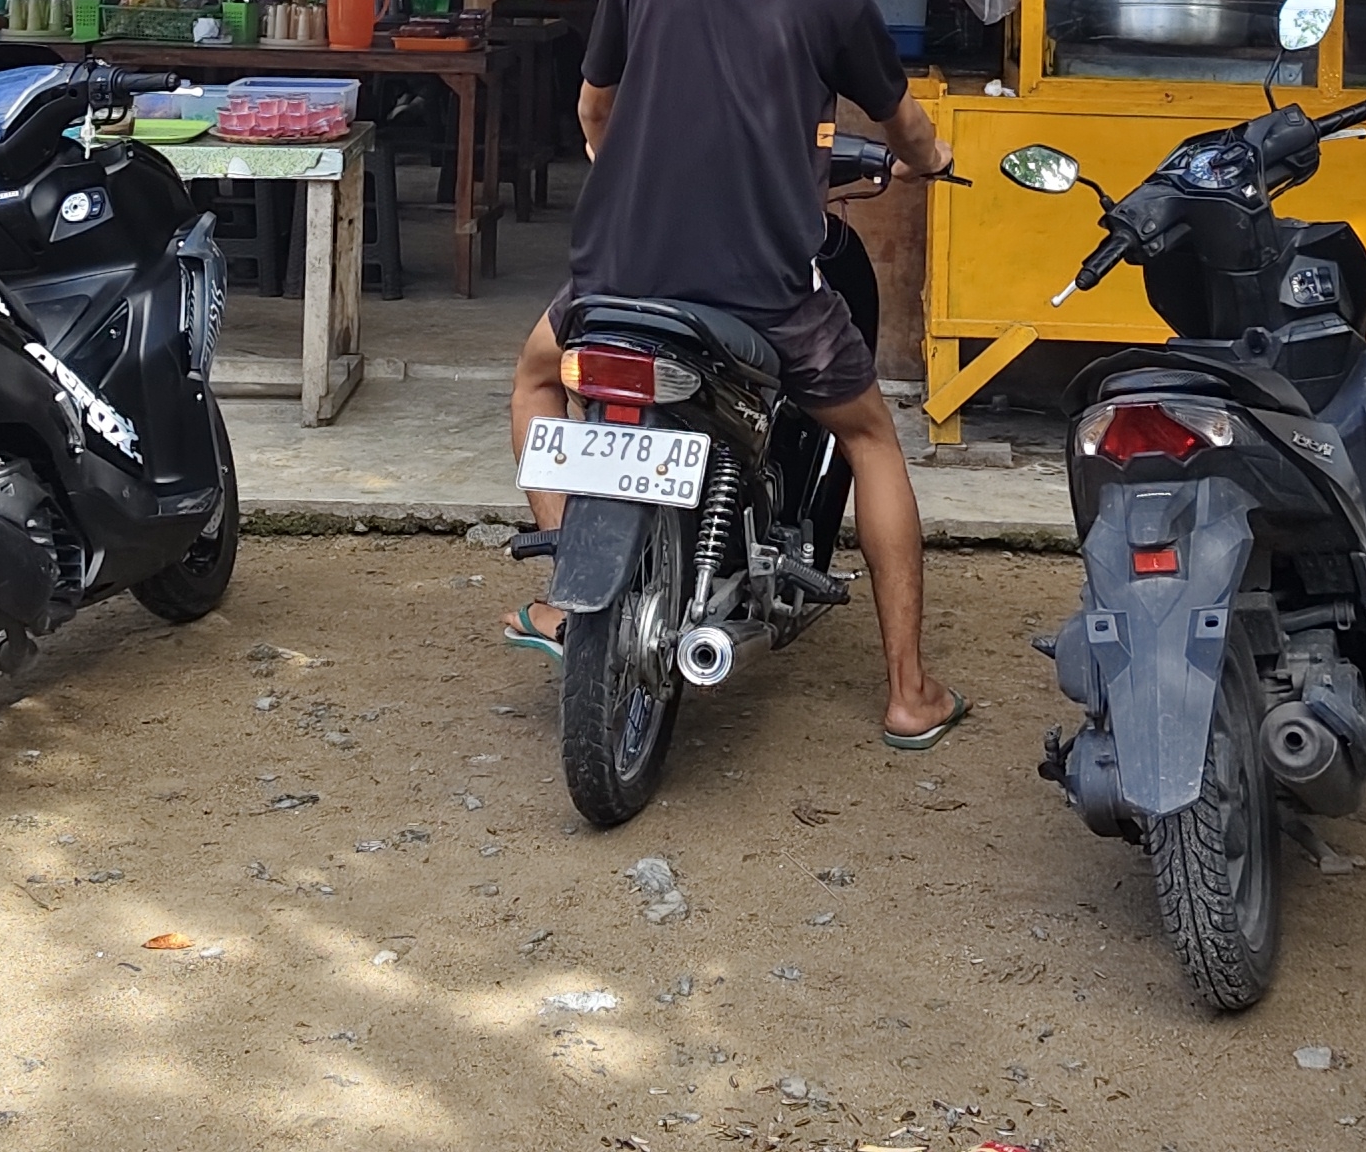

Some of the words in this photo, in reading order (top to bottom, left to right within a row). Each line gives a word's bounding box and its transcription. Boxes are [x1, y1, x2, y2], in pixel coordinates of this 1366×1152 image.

[530, 424, 565, 454] BA
[580, 429, 653, 462] 2378
[664, 438, 703, 468] AB
